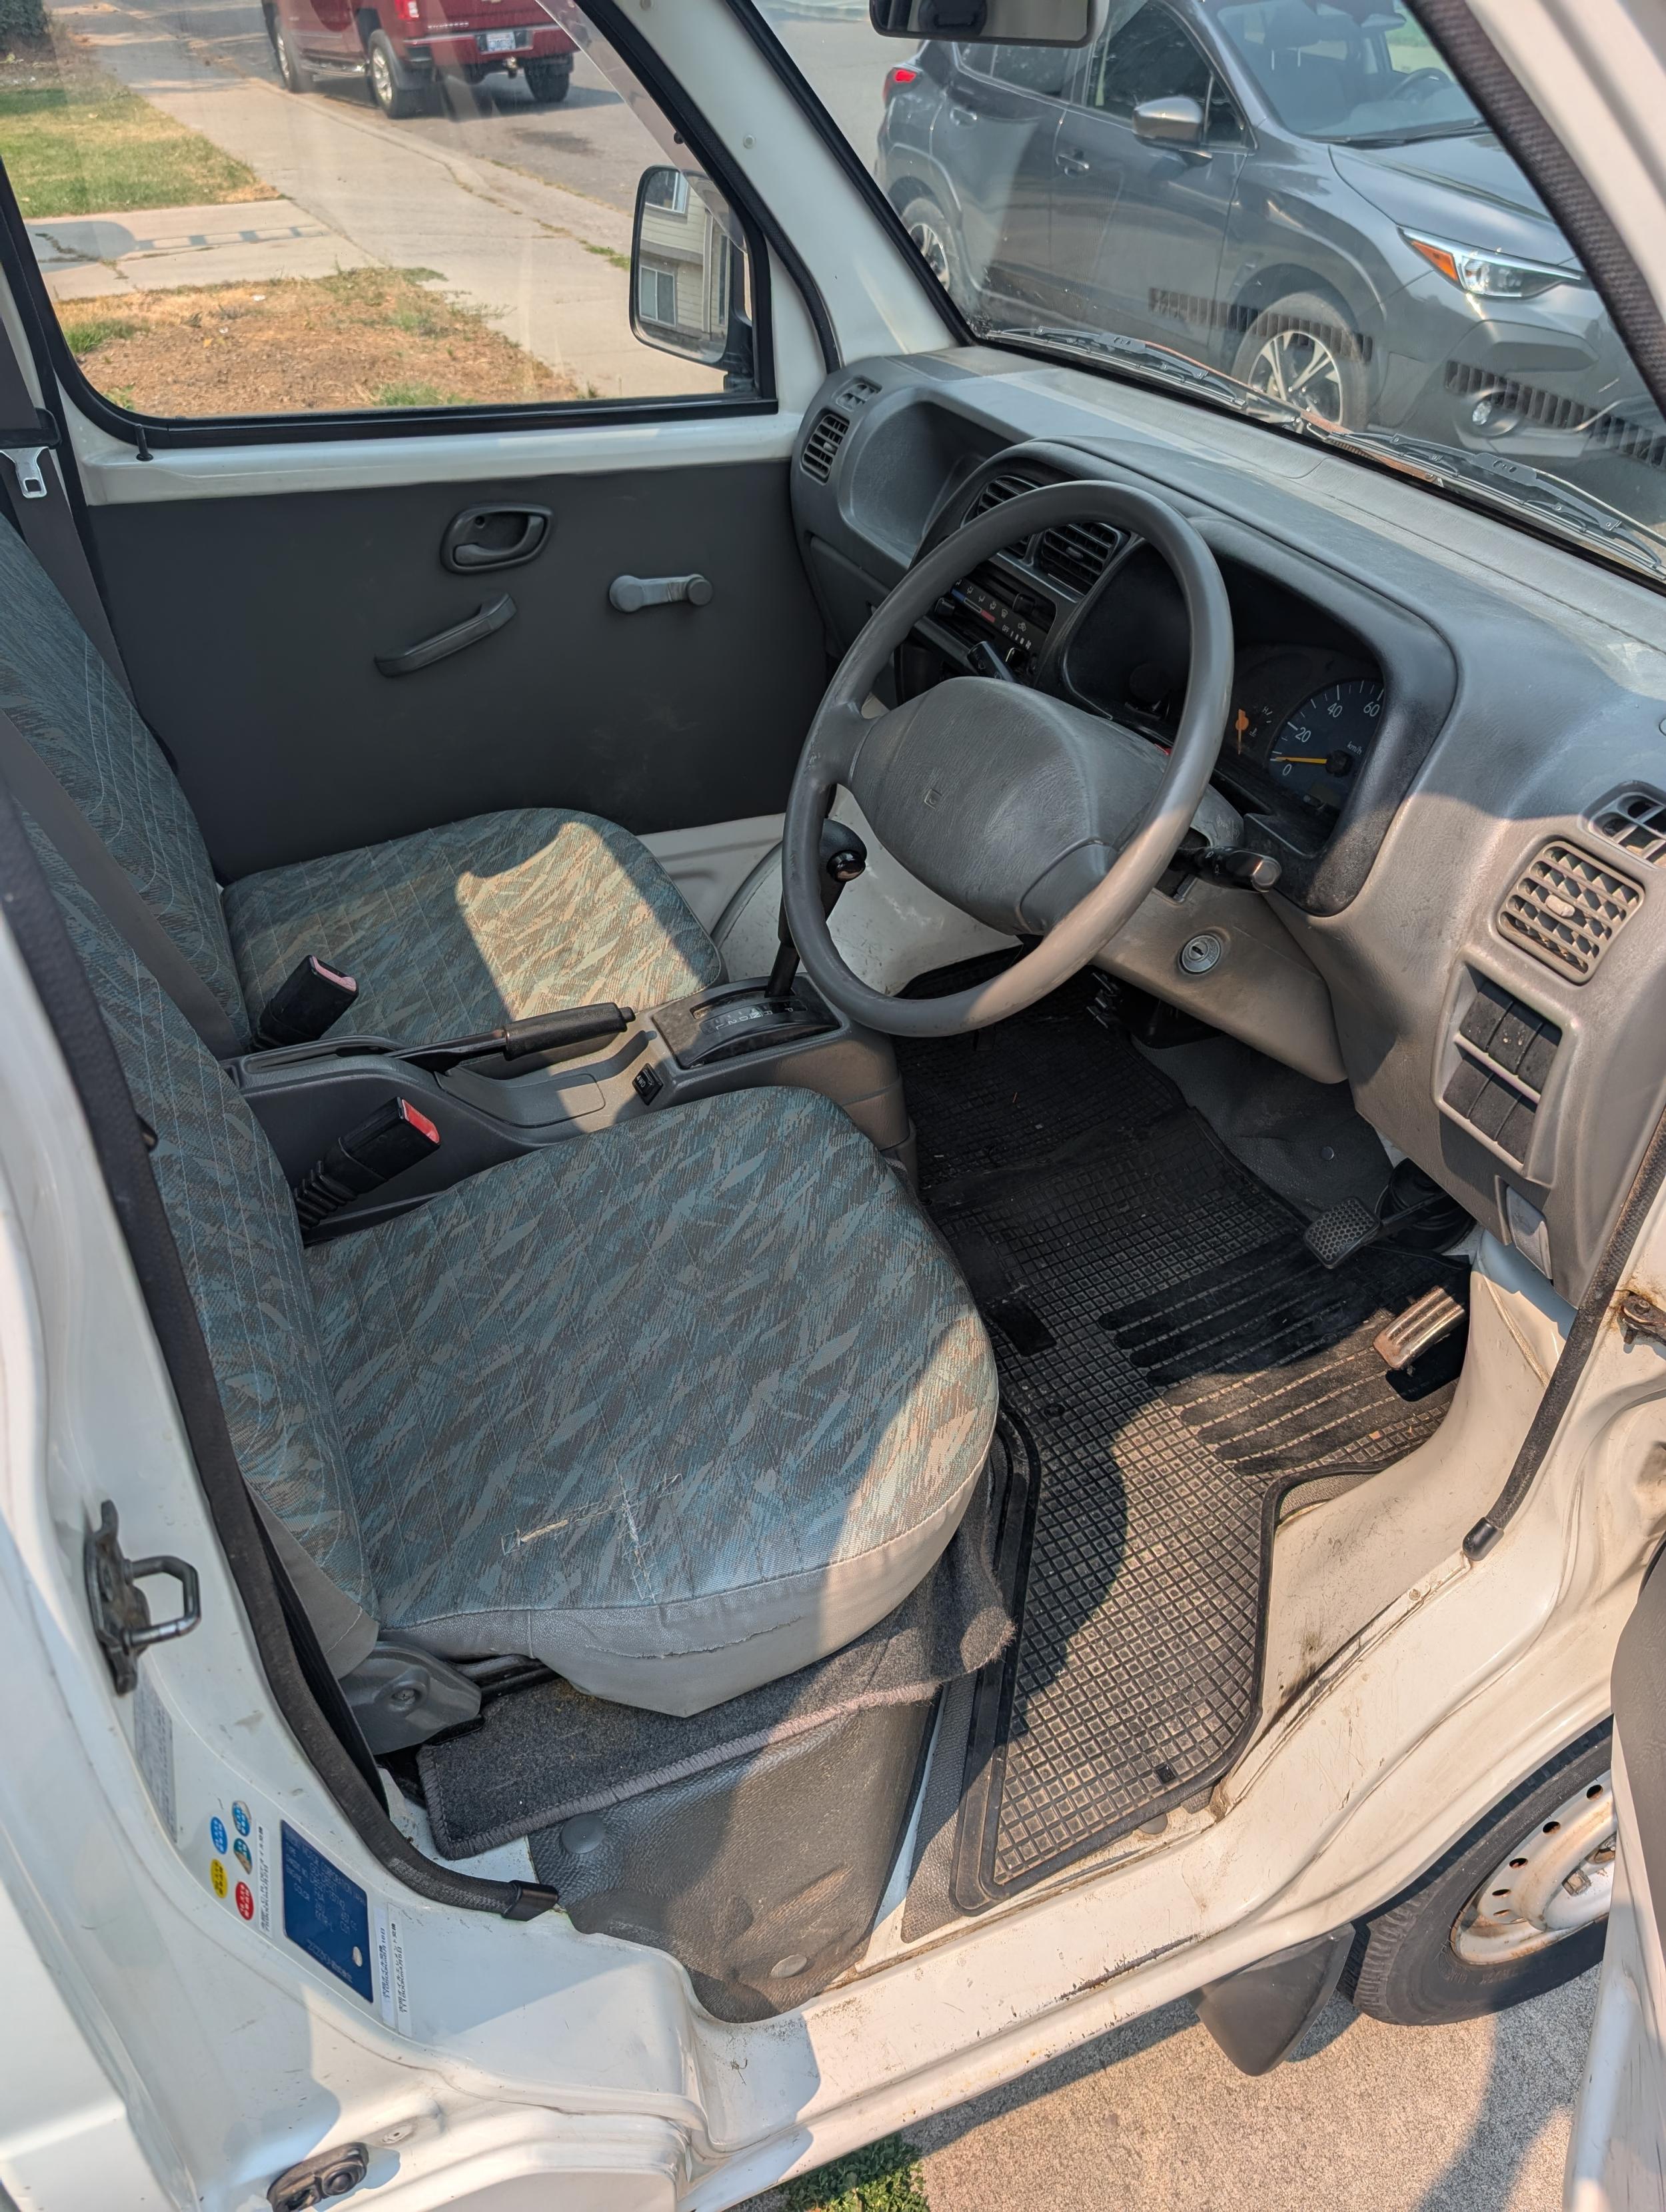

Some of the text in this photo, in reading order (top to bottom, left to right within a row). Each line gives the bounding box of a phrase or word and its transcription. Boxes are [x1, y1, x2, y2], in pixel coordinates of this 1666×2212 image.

[1327, 703, 1343, 718] 40
[1363, 702, 1380, 717] 60
[1295, 727, 1311, 742] 20
[1347, 741, 1362, 756] km/h
[1282, 764, 1292, 776] 0
[636, 1075, 646, 1087] 4WD
